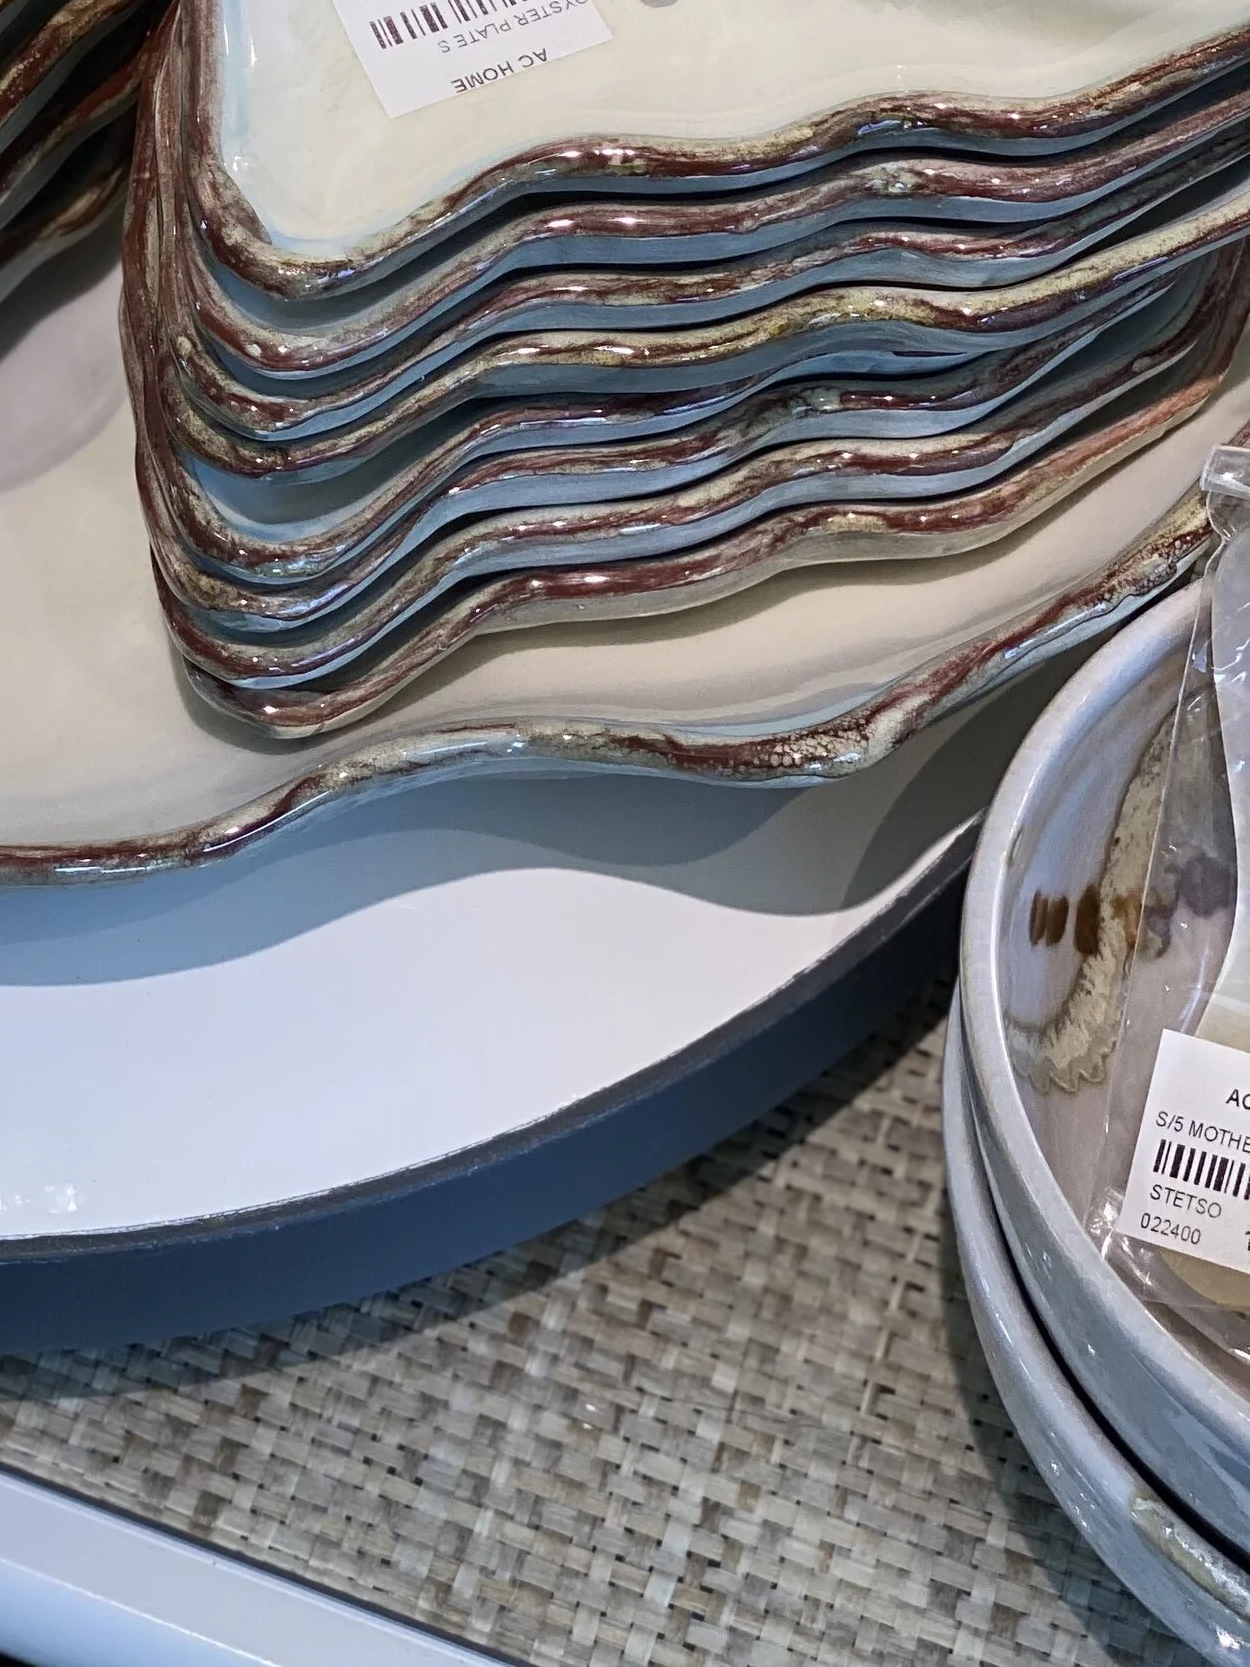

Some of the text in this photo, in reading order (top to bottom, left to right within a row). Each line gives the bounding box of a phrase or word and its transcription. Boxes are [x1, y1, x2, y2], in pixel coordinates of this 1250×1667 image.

[437, 39, 452, 53] S
[454, 20, 512, 49] PLATE
[450, 47, 549, 94] AC HOME
[1156, 1111, 1184, 1133] S/5
[1150, 1184, 1222, 1219] STETSO
[1141, 1213, 1201, 1245] 022400
